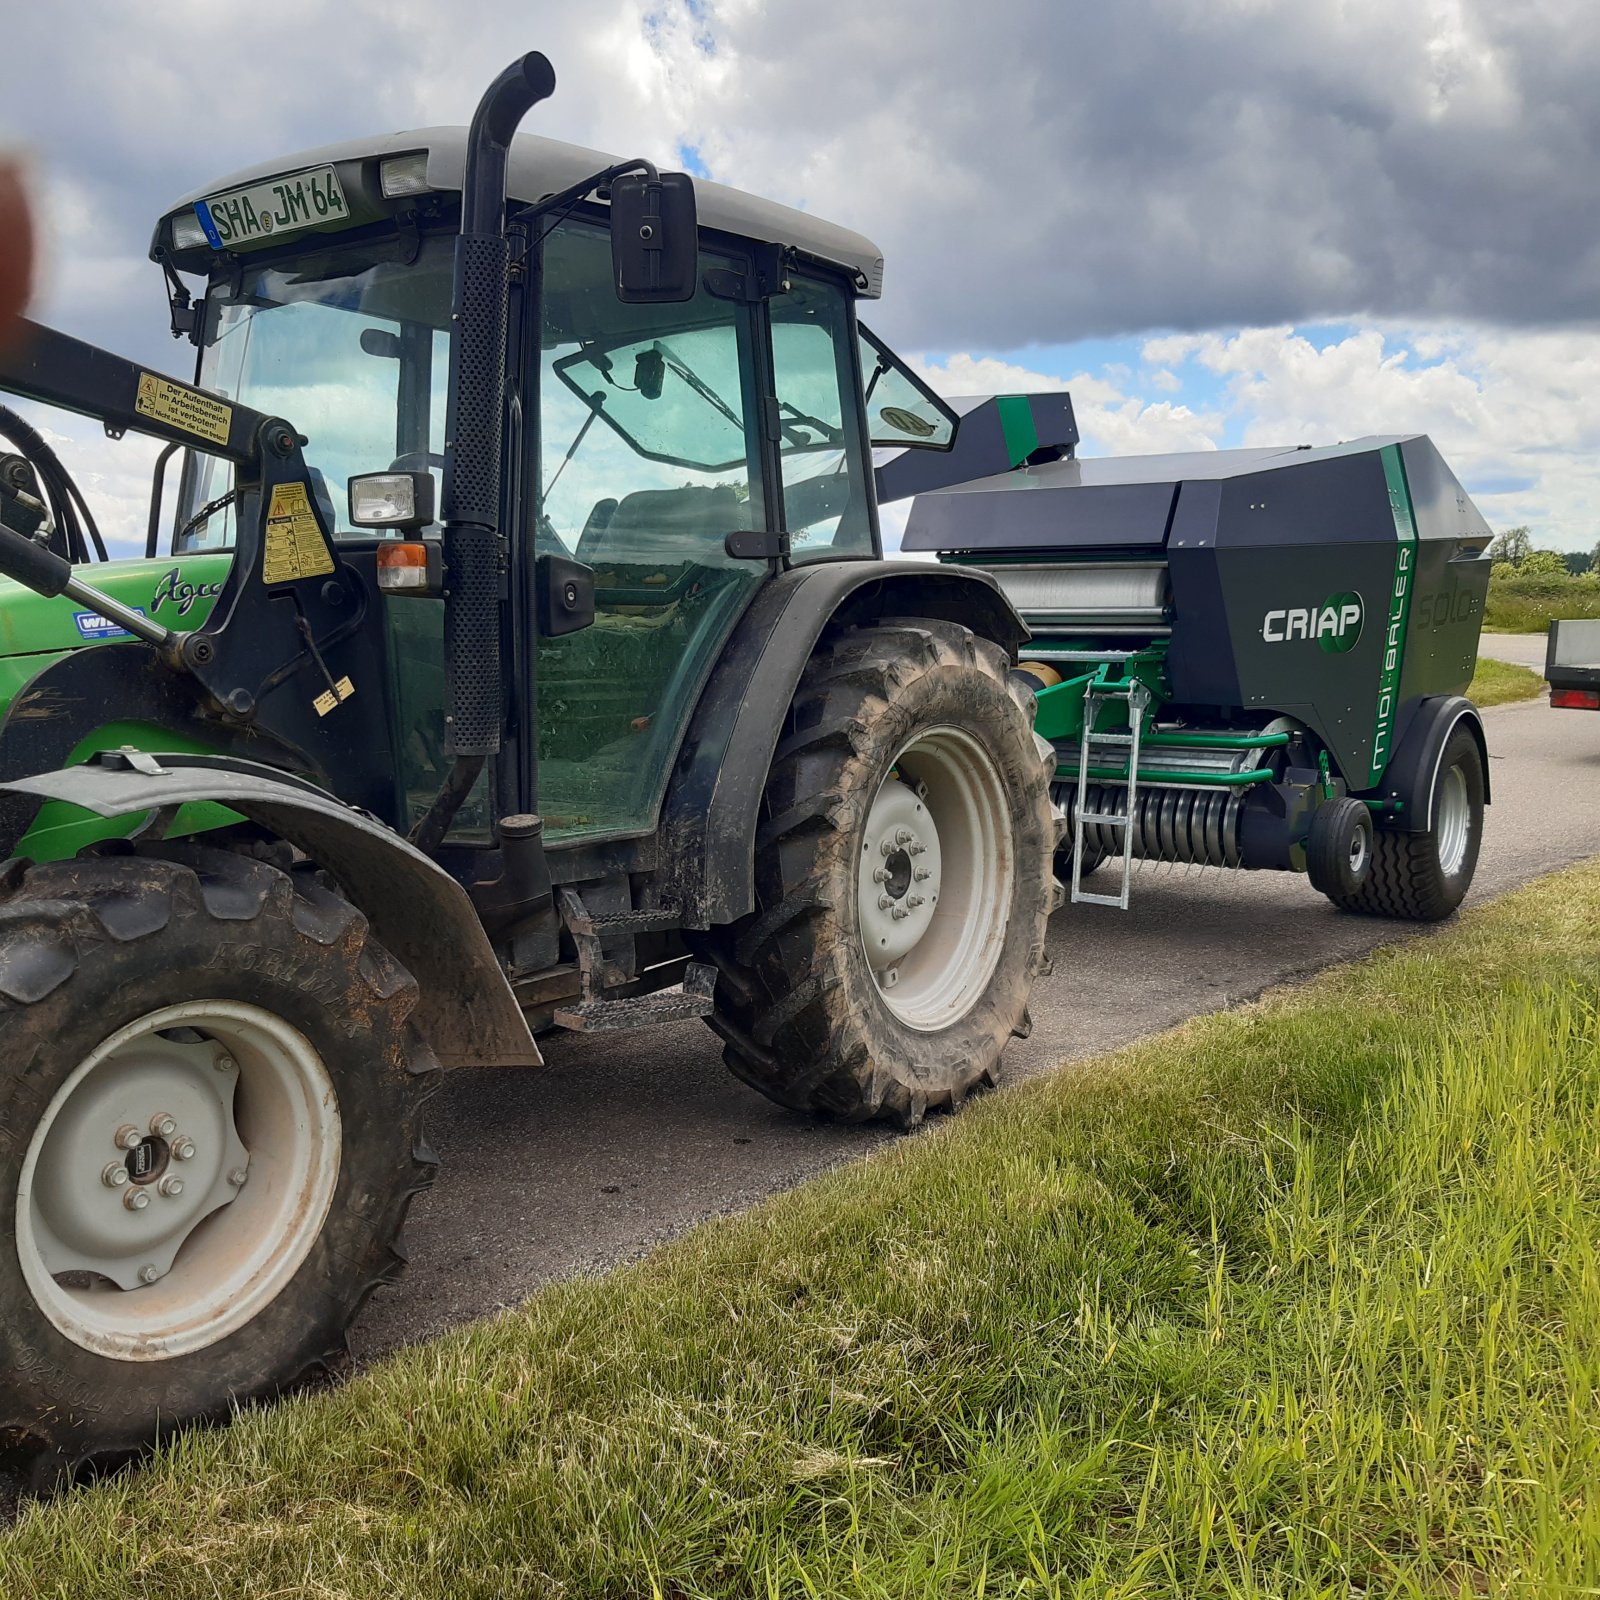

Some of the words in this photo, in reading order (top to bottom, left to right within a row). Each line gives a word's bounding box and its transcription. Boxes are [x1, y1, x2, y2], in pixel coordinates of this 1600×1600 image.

[210, 196, 261, 240] SHA
[272, 181, 310, 226] JM
[311, 173, 343, 216] 64
[159, 391, 169, 401] im
[171, 396, 228, 425] Arbeitsbereich
[167, 385, 182, 396] Der
[183, 392, 223, 414] Aufenthalt
[155, 409, 170, 420] Nicht
[171, 416, 186, 425] unter
[196, 426, 208, 435] Last
[209, 431, 227, 442] treten!
[168, 404, 178, 414] ist
[180, 411, 217, 430] verboten!
[1417, 576, 1473, 630] solo
[1262, 604, 1360, 643] CRIAP
